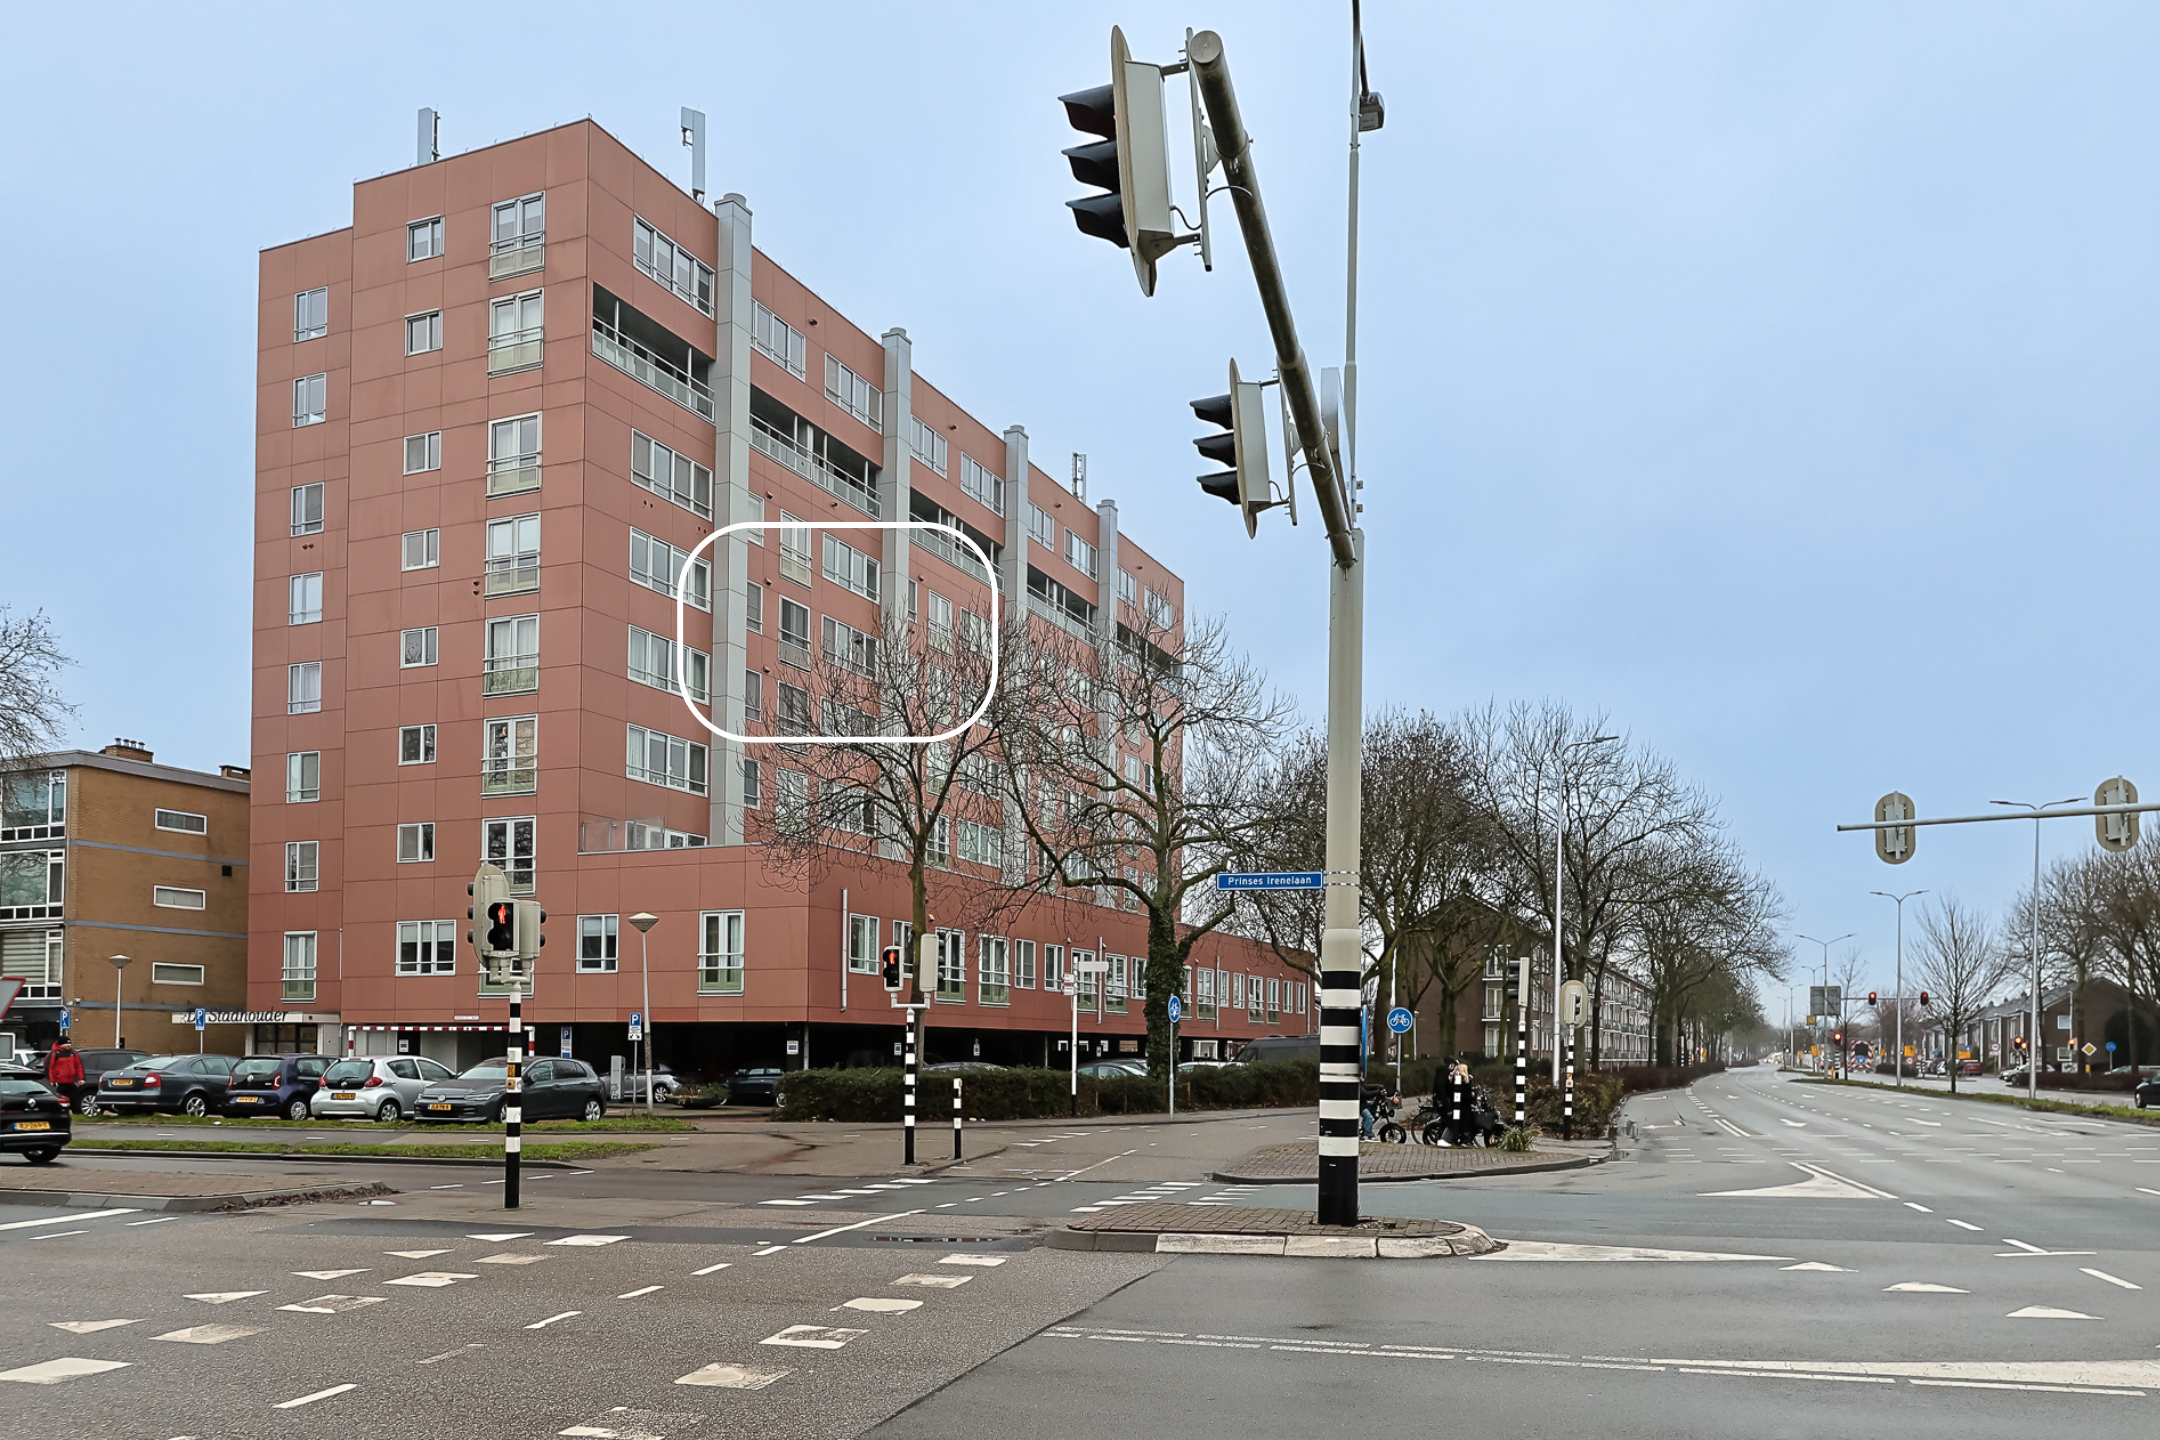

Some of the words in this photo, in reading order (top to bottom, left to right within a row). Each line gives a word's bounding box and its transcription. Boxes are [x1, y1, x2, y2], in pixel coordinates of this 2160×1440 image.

[1228, 877, 1263, 886] Prinses
[1266, 876, 1312, 885] Irenelaan
[209, 1006, 289, 1023] Stadhouder
[631, 1013, 639, 1025] P
